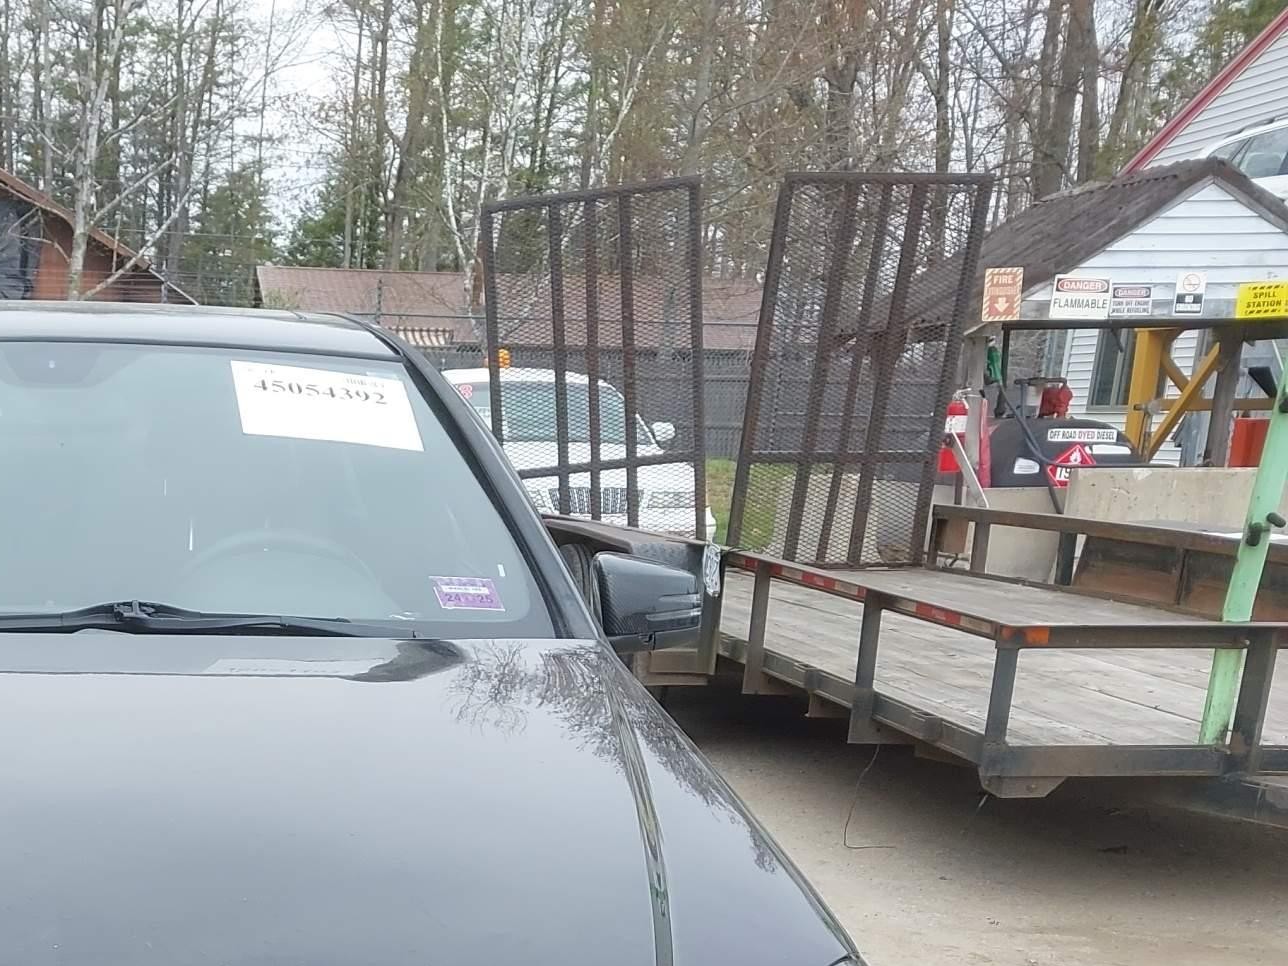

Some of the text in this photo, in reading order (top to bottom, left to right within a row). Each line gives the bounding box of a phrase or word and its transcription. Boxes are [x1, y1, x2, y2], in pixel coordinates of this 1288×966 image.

[993, 274, 1014, 284] FIRE
[1063, 281, 1102, 290] DANGER
[1253, 291, 1278, 299] SPILL
[1053, 298, 1108, 309] FLAMMABLE
[1246, 299, 1282, 309] STATION
[253, 379, 388, 405] 45054392
[1049, 430, 1115, 441] OFF ROAD DYED DIESEL
